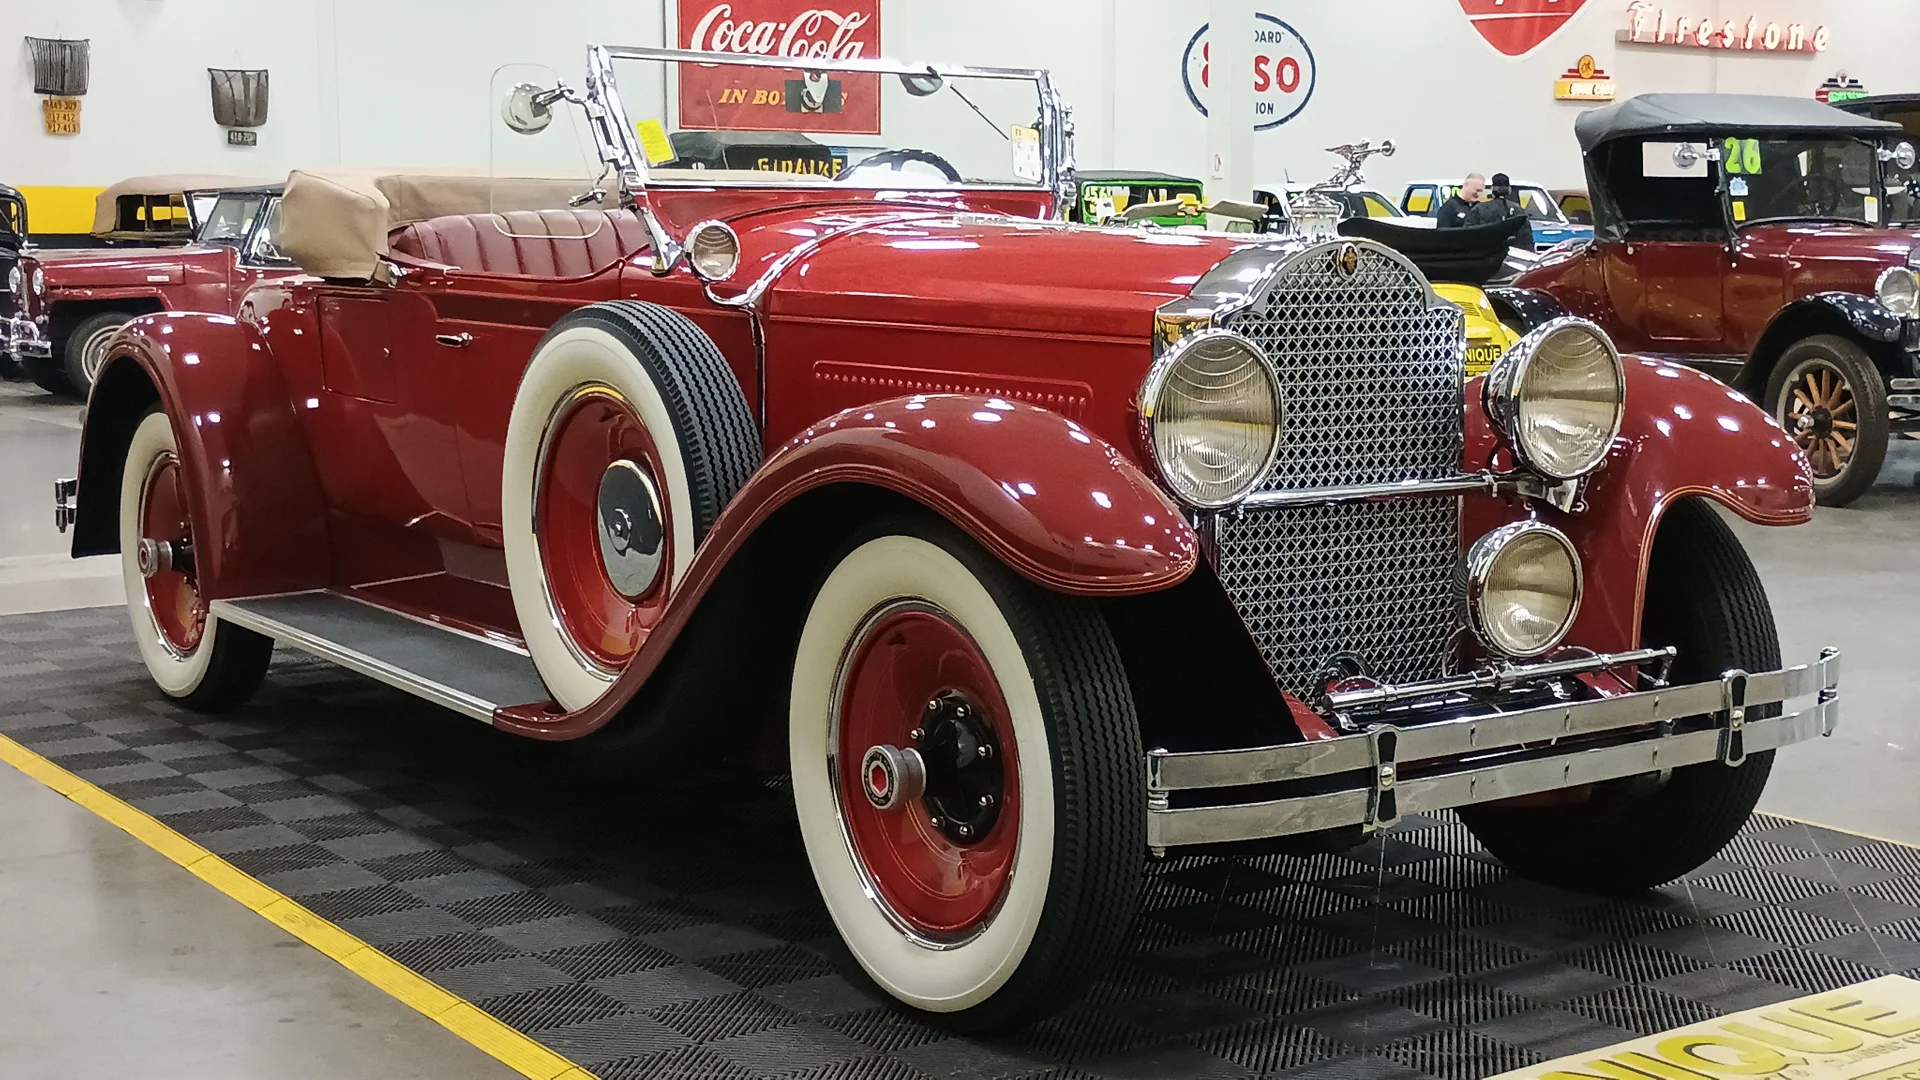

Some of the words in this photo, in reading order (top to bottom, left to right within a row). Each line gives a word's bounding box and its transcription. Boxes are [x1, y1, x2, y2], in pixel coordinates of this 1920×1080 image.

[691, 4, 871, 72] Coca-Cola
[1254, 30, 1282, 43] DARD
[1626, 1, 1830, 52] Firestone
[718, 88, 747, 105] IN
[1725, 137, 1761, 173] 26
[1465, 348, 1501, 361] NIQUE
